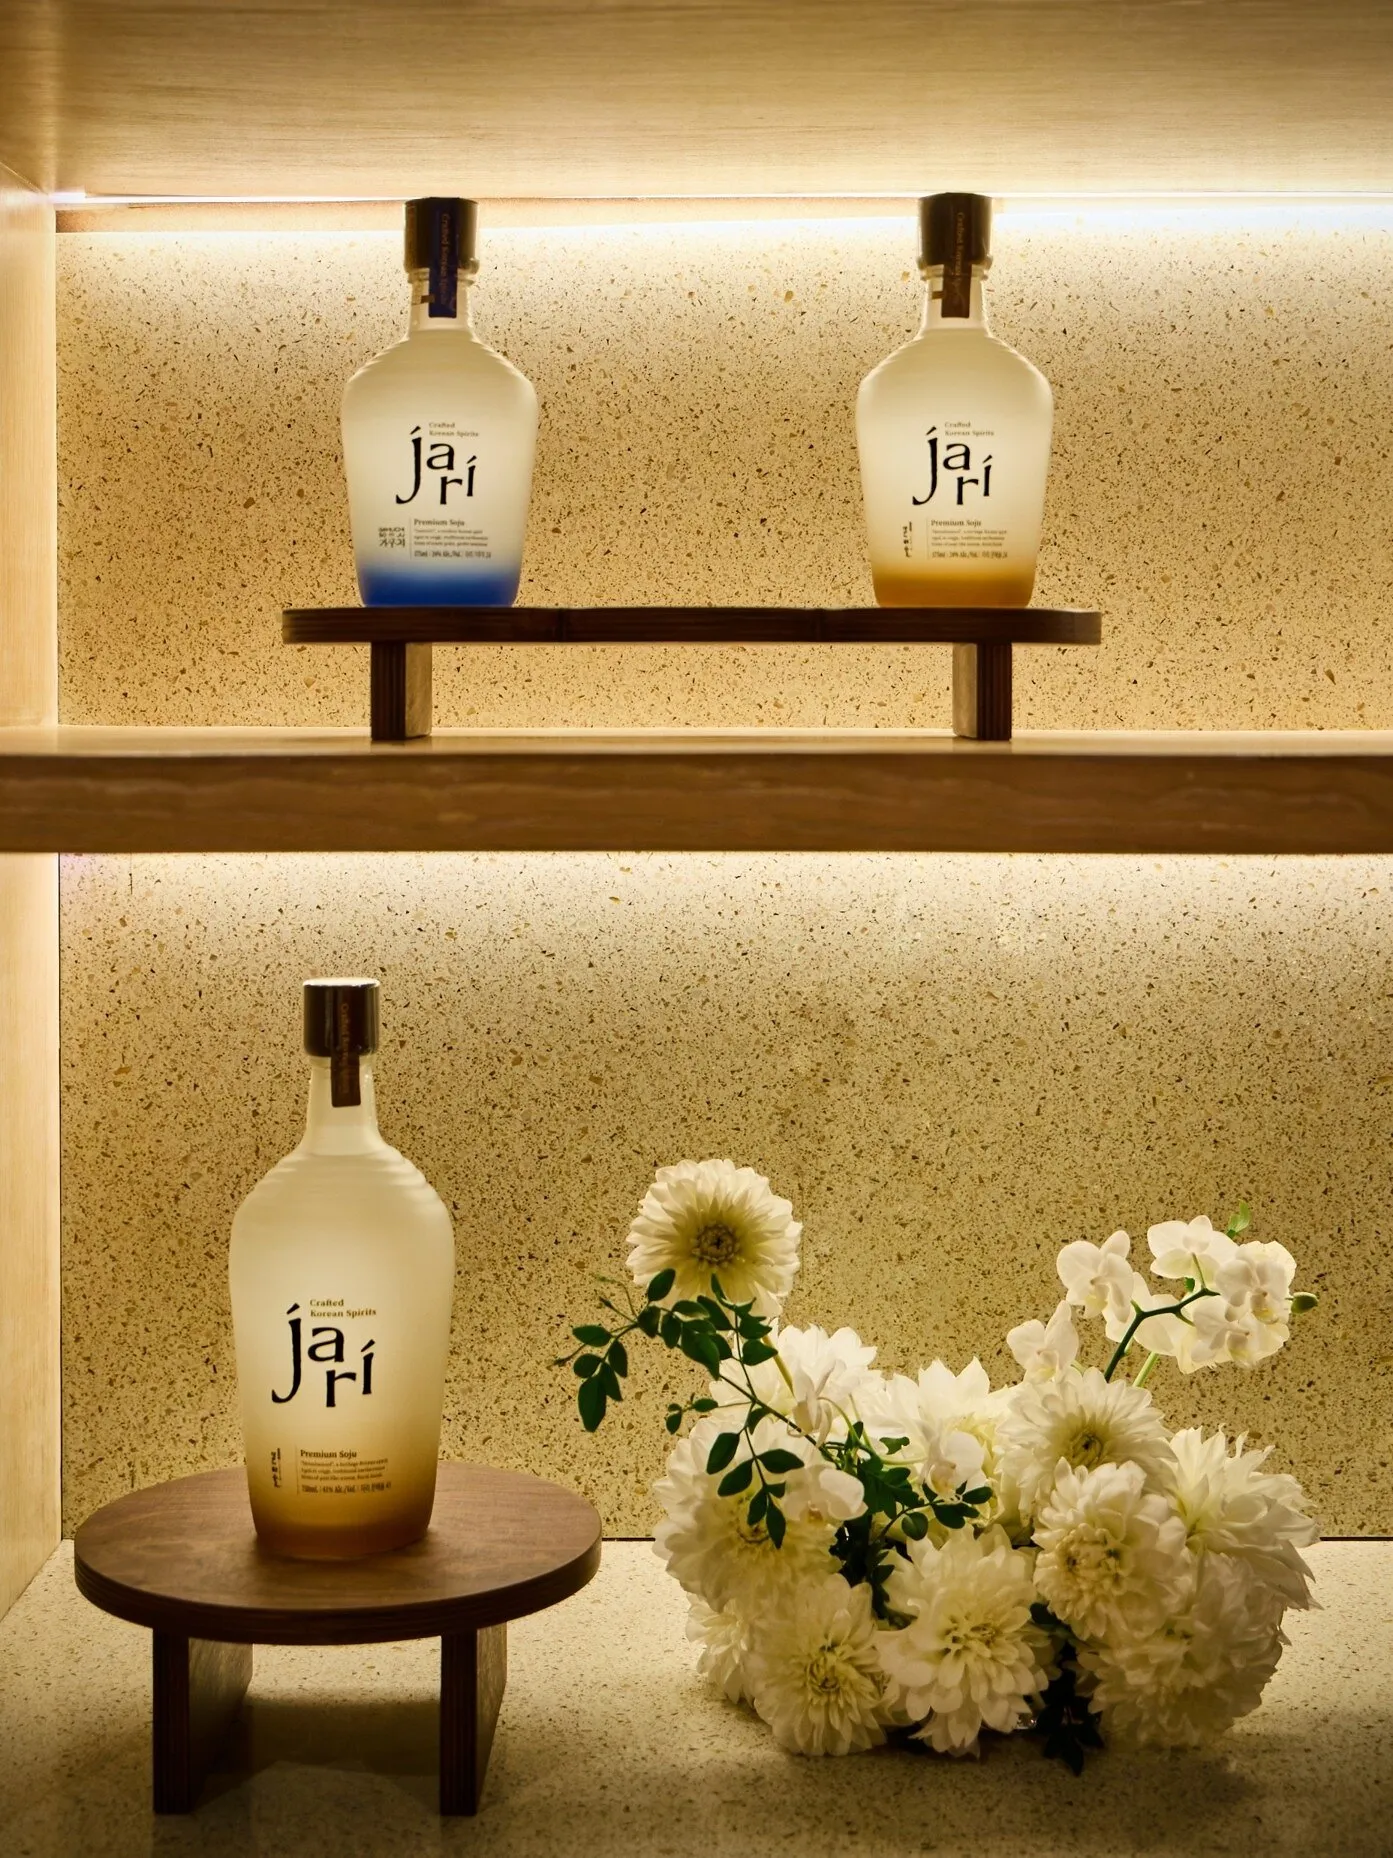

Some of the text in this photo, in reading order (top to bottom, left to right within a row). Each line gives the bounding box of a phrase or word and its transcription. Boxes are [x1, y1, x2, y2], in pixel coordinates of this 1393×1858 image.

[457, 430, 479, 438] Spirits
[414, 518, 465, 528] Premium Soju
[966, 519, 982, 528] Soju
[309, 1299, 344, 1307] Crafted
[310, 1308, 377, 1319] Korean Spirits
[300, 1449, 357, 1460] Premium Soju
